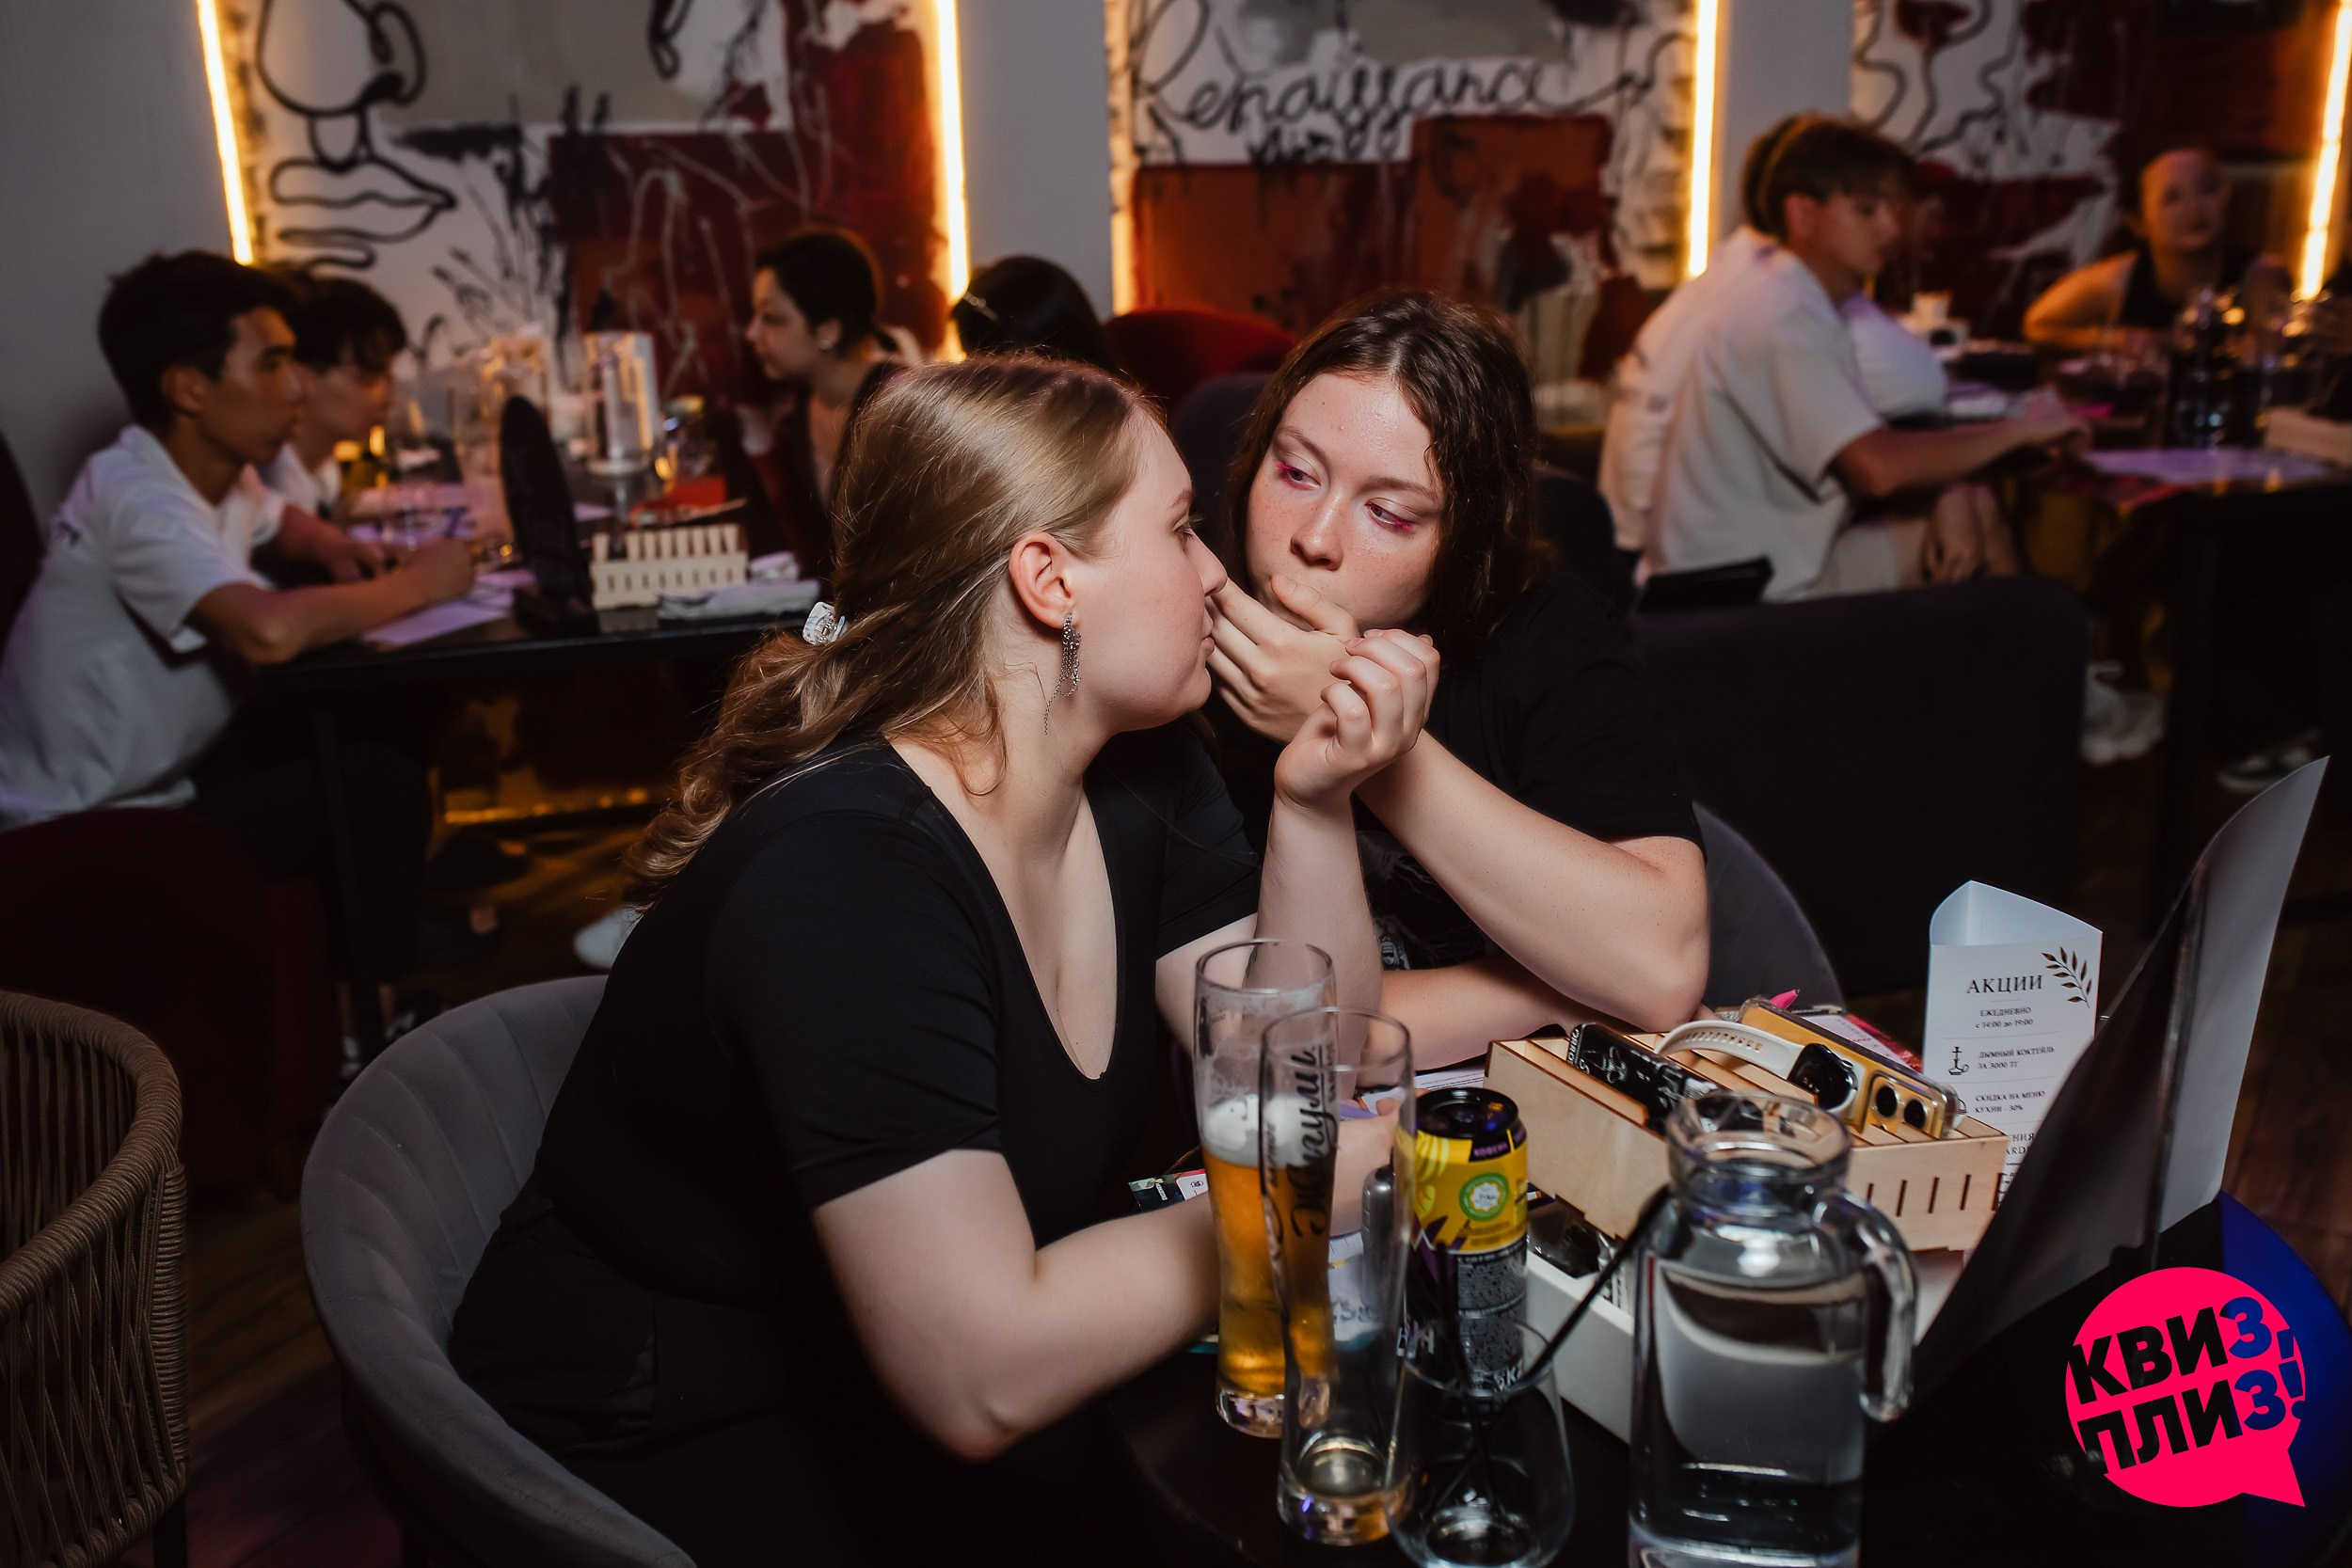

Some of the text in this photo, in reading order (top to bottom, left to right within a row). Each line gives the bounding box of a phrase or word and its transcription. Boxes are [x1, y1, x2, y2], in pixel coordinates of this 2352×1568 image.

[1966, 974, 2042, 993] АКЦИИ
[1979, 1007, 2032, 1017] ЕЖЕДНЕВНО
[1979, 1046, 2055, 1058] ДЫМНЫЙ КОКТЕЙЛЬ
